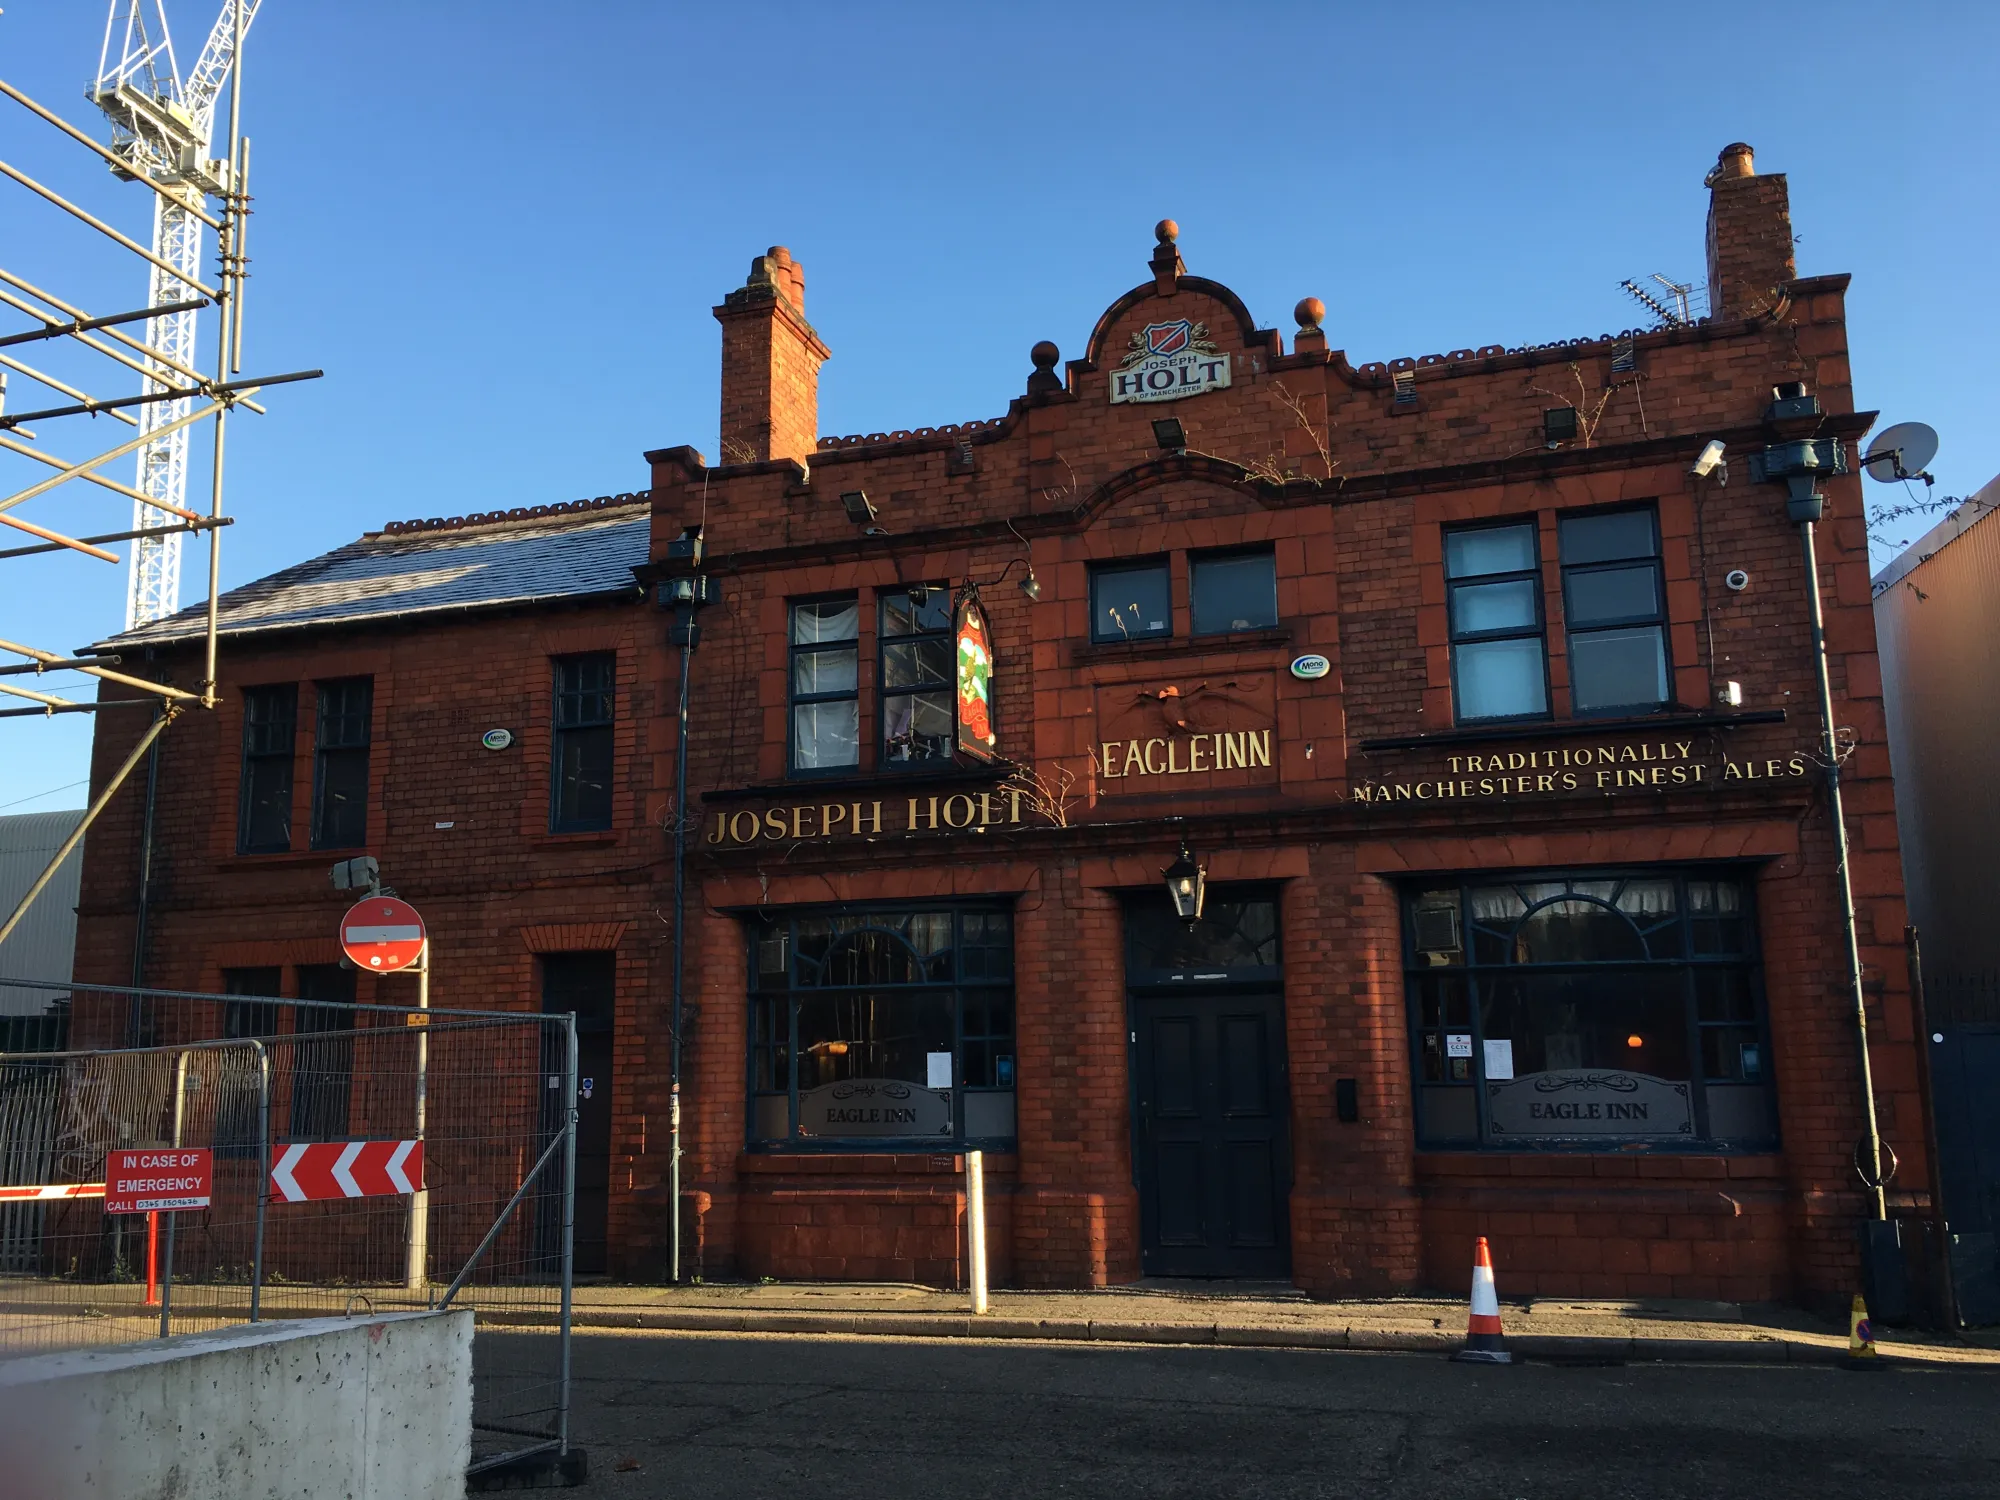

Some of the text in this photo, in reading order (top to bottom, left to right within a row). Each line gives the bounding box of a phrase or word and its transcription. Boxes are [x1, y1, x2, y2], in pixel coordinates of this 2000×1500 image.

[1142, 355, 1197, 371] JOSEPH
[1117, 360, 1225, 396] HOLT
[1150, 385, 1202, 397] MANCHESTER
[1302, 661, 1324, 670] Mono
[1447, 741, 1692, 774] TRADITIONALLY
[1354, 758, 1805, 802] MANCHESTER'S FINEST ALES
[707, 792, 1023, 844] JOSEPH HOLT
[827, 1108, 916, 1123] EAGLE INN
[1529, 1102, 1648, 1119] EAGLE INN
[123, 1154, 199, 1168] IN CASE OF
[117, 1177, 202, 1193] EMERGENCY
[107, 1201, 133, 1211] CALL
[138, 1200, 159, 1208] 0345
